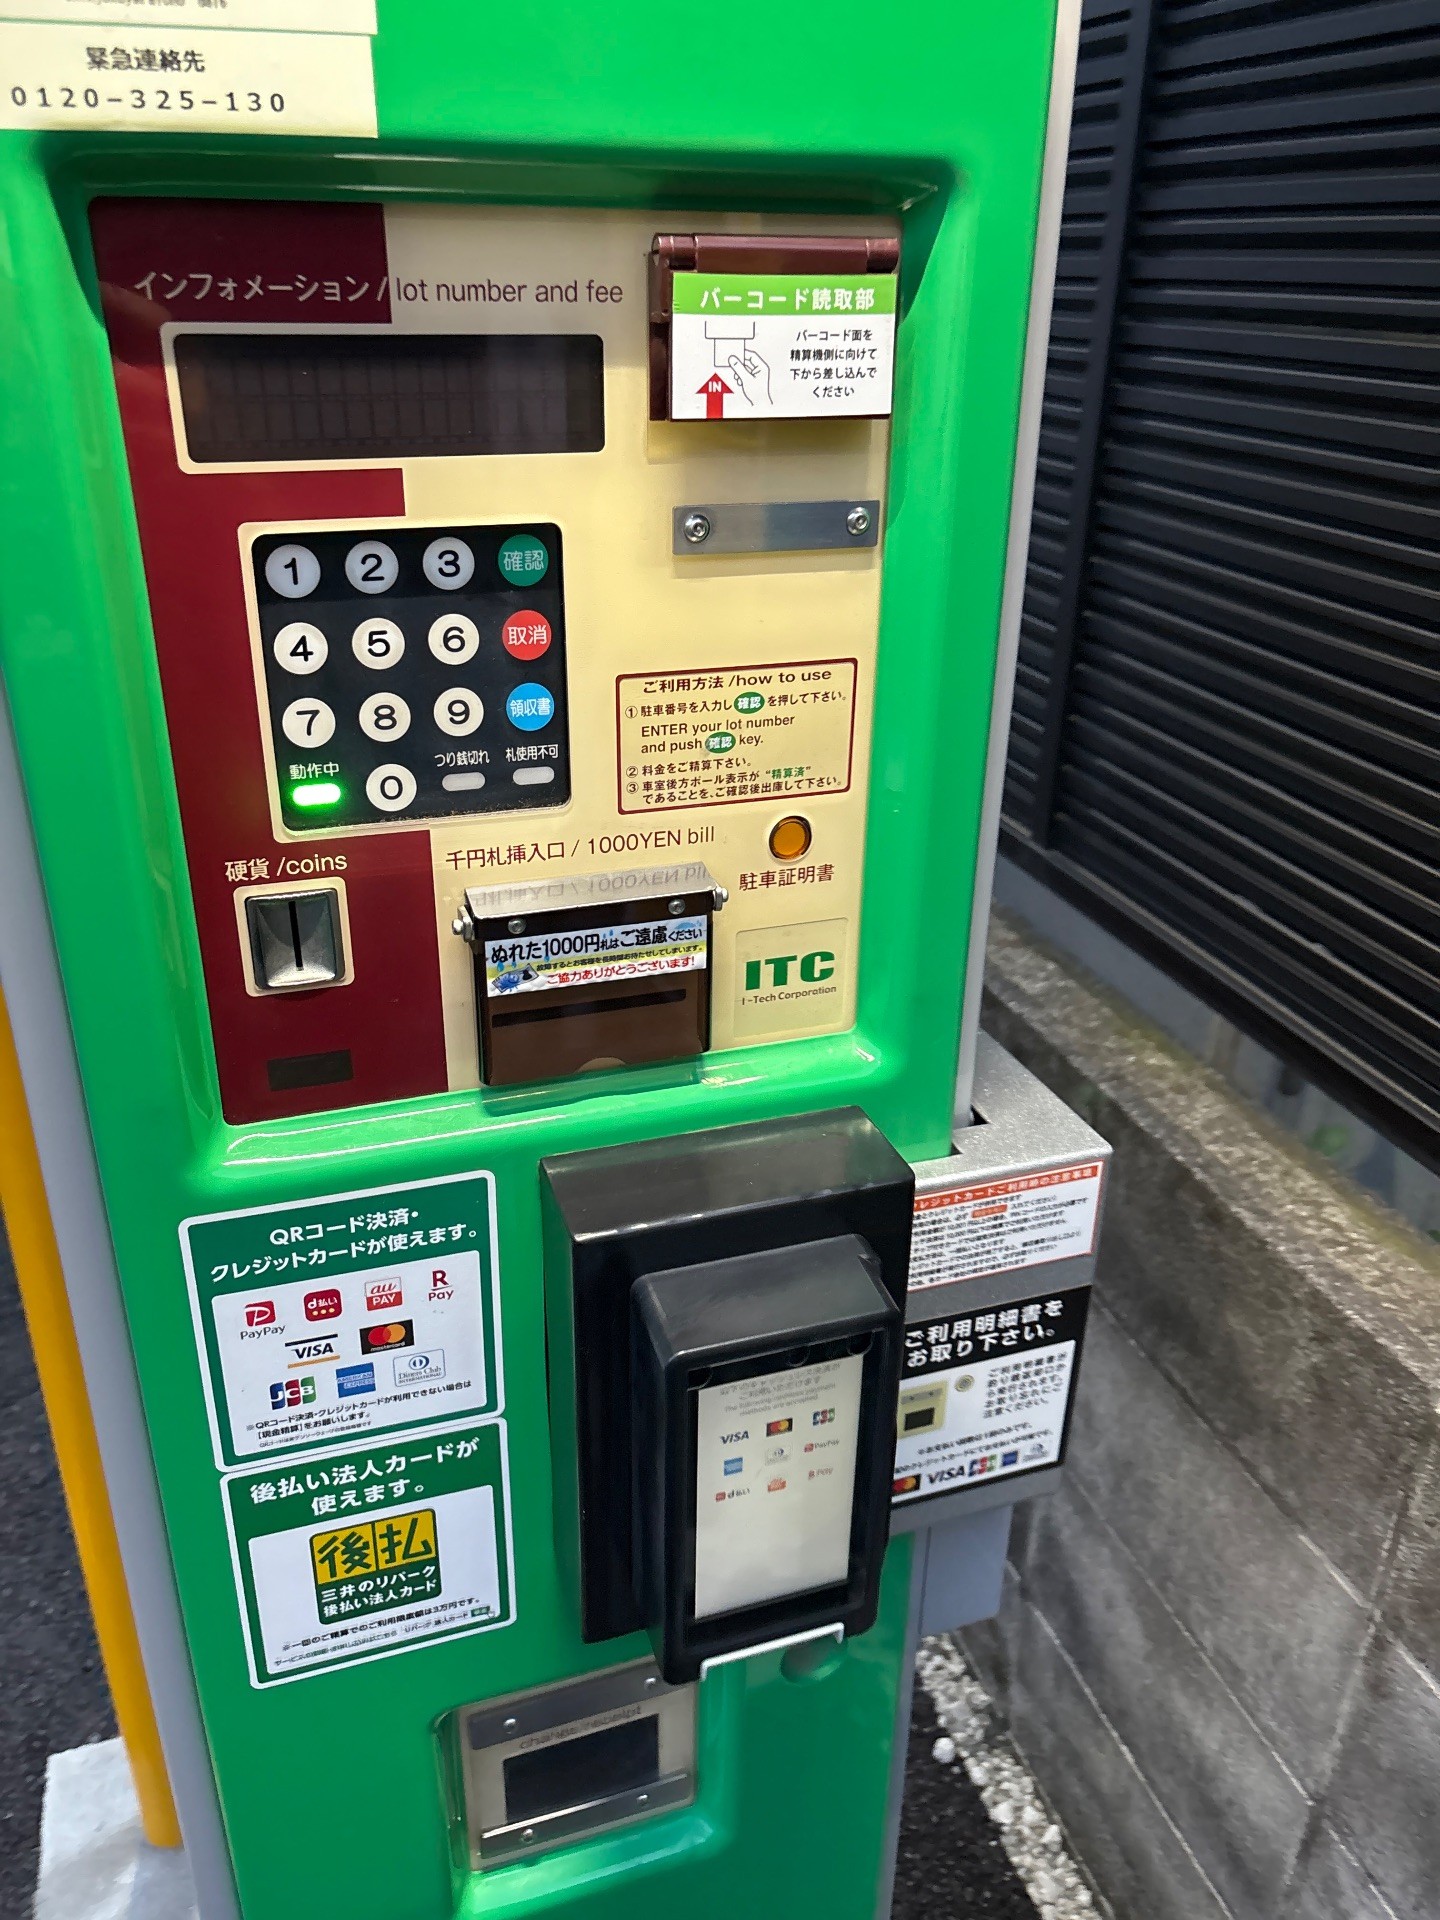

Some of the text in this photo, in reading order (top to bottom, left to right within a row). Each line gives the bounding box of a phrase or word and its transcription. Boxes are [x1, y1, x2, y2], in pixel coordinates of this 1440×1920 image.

[86, 46, 205, 72] 緊急連絡先
[11, 87, 285, 113] 0120-325-130
[134, 272, 370, 301] インフォメーション
[396, 277, 429, 302] lot
[436, 279, 526, 302] number
[535, 280, 578, 302] and
[585, 281, 623, 303] fee
[700, 288, 875, 310] バーコード読取部
[796, 329, 872, 342] バーコード面を
[789, 348, 877, 362] 精算機側に向けて
[708, 381, 722, 392] IN
[789, 367, 877, 381] 下から差し込んで
[812, 385, 855, 398] ください
[284, 557, 298, 585] 1
[361, 553, 385, 582] 2
[437, 550, 461, 577] 3
[503, 551, 544, 571] 確認
[367, 630, 390, 657] 5
[442, 626, 466, 652] 6
[507, 624, 548, 645] 取消
[290, 635, 313, 662] 4
[642, 675, 724, 694] ご利用方法
[779, 672, 795, 684] to
[801, 670, 832, 682] use
[447, 699, 470, 725] 9
[509, 697, 551, 718] 領収書
[640, 699, 732, 717] 駐車番号を入力し
[736, 694, 762, 710] 確認
[767, 690, 847, 707] を押して下さい。
[295, 709, 320, 736] 7
[373, 704, 397, 730] 8
[641, 714, 795, 738] ENTER your lot number
[505, 743, 559, 761] 札使用不可
[640, 733, 764, 755] and push 確認 key.
[289, 761, 339, 780] 動作中
[434, 749, 490, 767] つり銭切れ
[641, 757, 752, 777] 料金をご精算下さい。
[380, 775, 403, 800] 0
[642, 775, 842, 805] であることを、ご確認後出庫して下さい。
[446, 841, 565, 871] 千円札挿入口
[588, 829, 682, 855] 1000YEN
[687, 826, 715, 844] bill
[225, 853, 348, 882] 硬貨 /coins
[739, 863, 835, 891] 駐車証明書
[491, 925, 703, 964] ぬれた1000円札はご遠慮ください
[745, 951, 835, 991] ITC
[778, 986, 837, 1000] Corporation
[269, 1208, 419, 1247] QRコード決済・
[210, 1223, 478, 1284] クレジットカードが使えます。
[370, 1282, 397, 1295] au
[372, 1294, 396, 1306] PAY
[428, 1289, 454, 1303] Pay
[307, 1296, 338, 1311] d払い
[240, 1324, 286, 1342] PayPay
[905, 1300, 1063, 1348] ご利用明細書を
[294, 1341, 336, 1361] VISA
[370, 1341, 406, 1352] mastercard
[907, 1324, 1055, 1368] お取り下さい。
[270, 1381, 317, 1406] JCB
[720, 1430, 750, 1445] VISA
[250, 1437, 481, 1505] 後払い法人カードが
[927, 1465, 965, 1484] VISA
[310, 1478, 425, 1517] 使えます。
[317, 1516, 435, 1579] 後払
[321, 1564, 436, 1604] 三井のリパーク
[323, 1578, 437, 1618] 後払い法人カード
